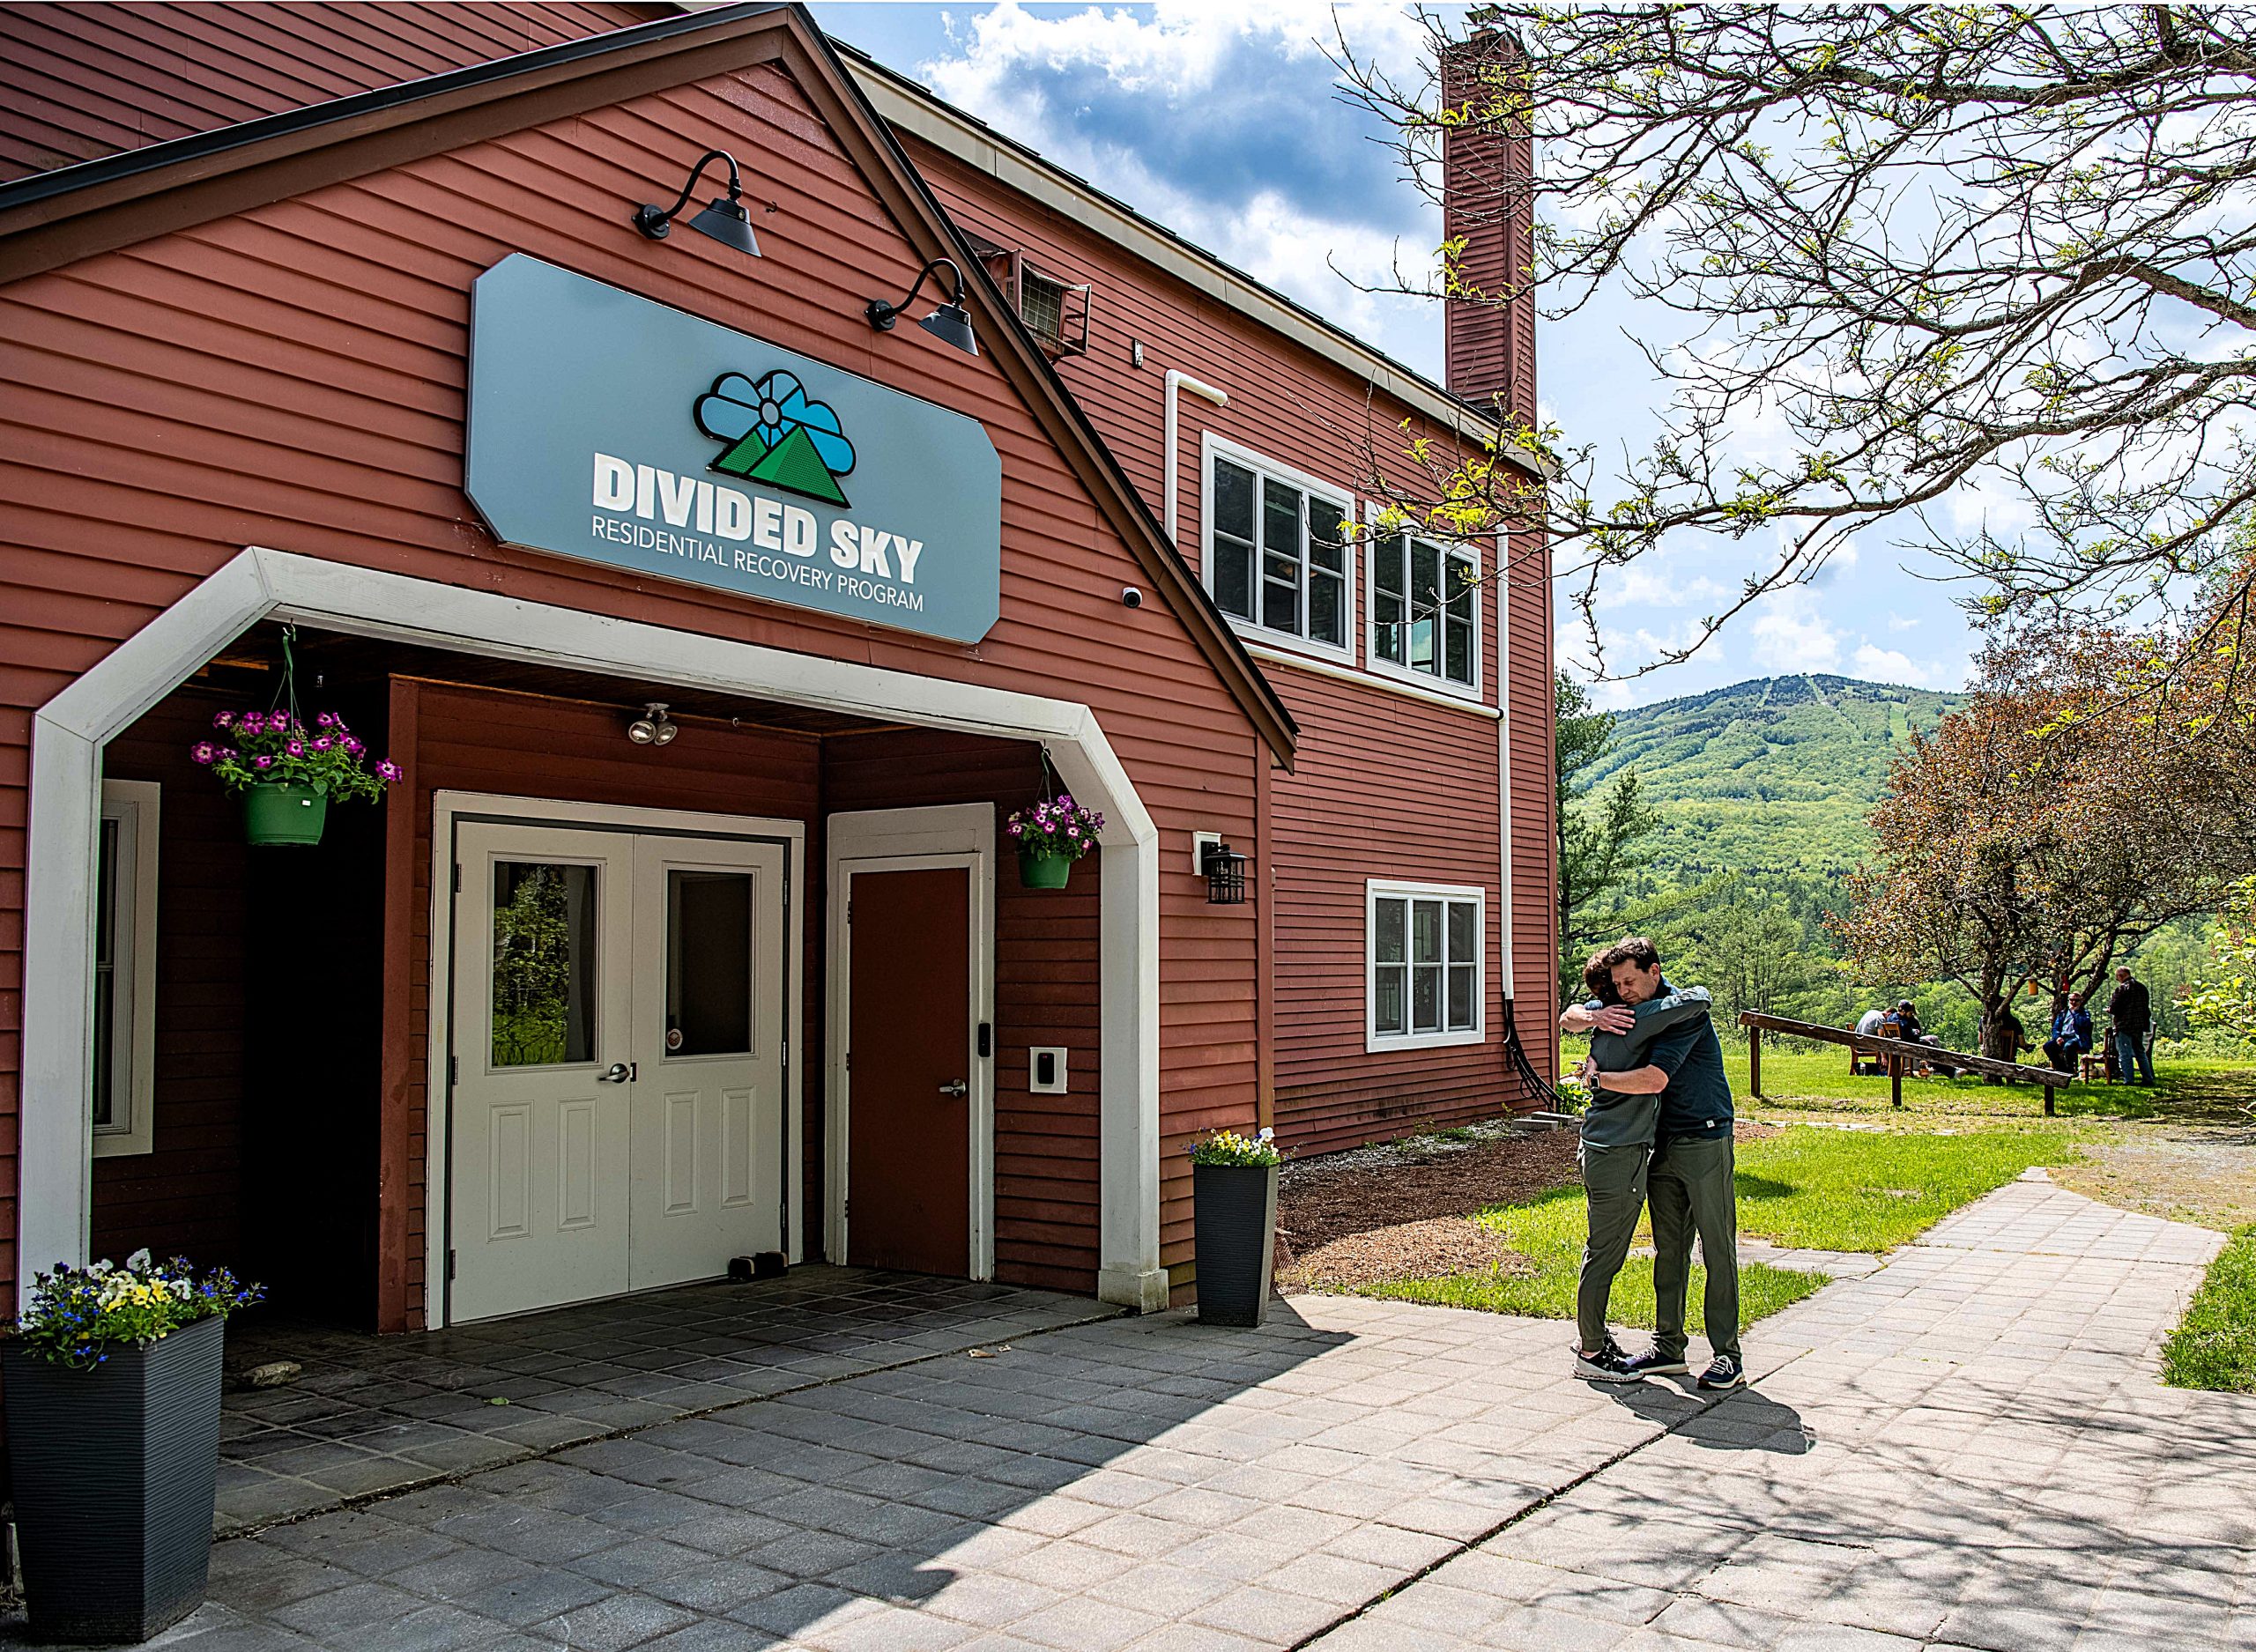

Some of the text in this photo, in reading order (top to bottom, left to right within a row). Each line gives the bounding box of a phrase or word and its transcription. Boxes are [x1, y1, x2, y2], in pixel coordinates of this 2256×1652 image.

[592, 452, 924, 584] DIVIDED SKY
[592, 515, 924, 612] RESIDENTIAL RECOVERY PROGRAM
